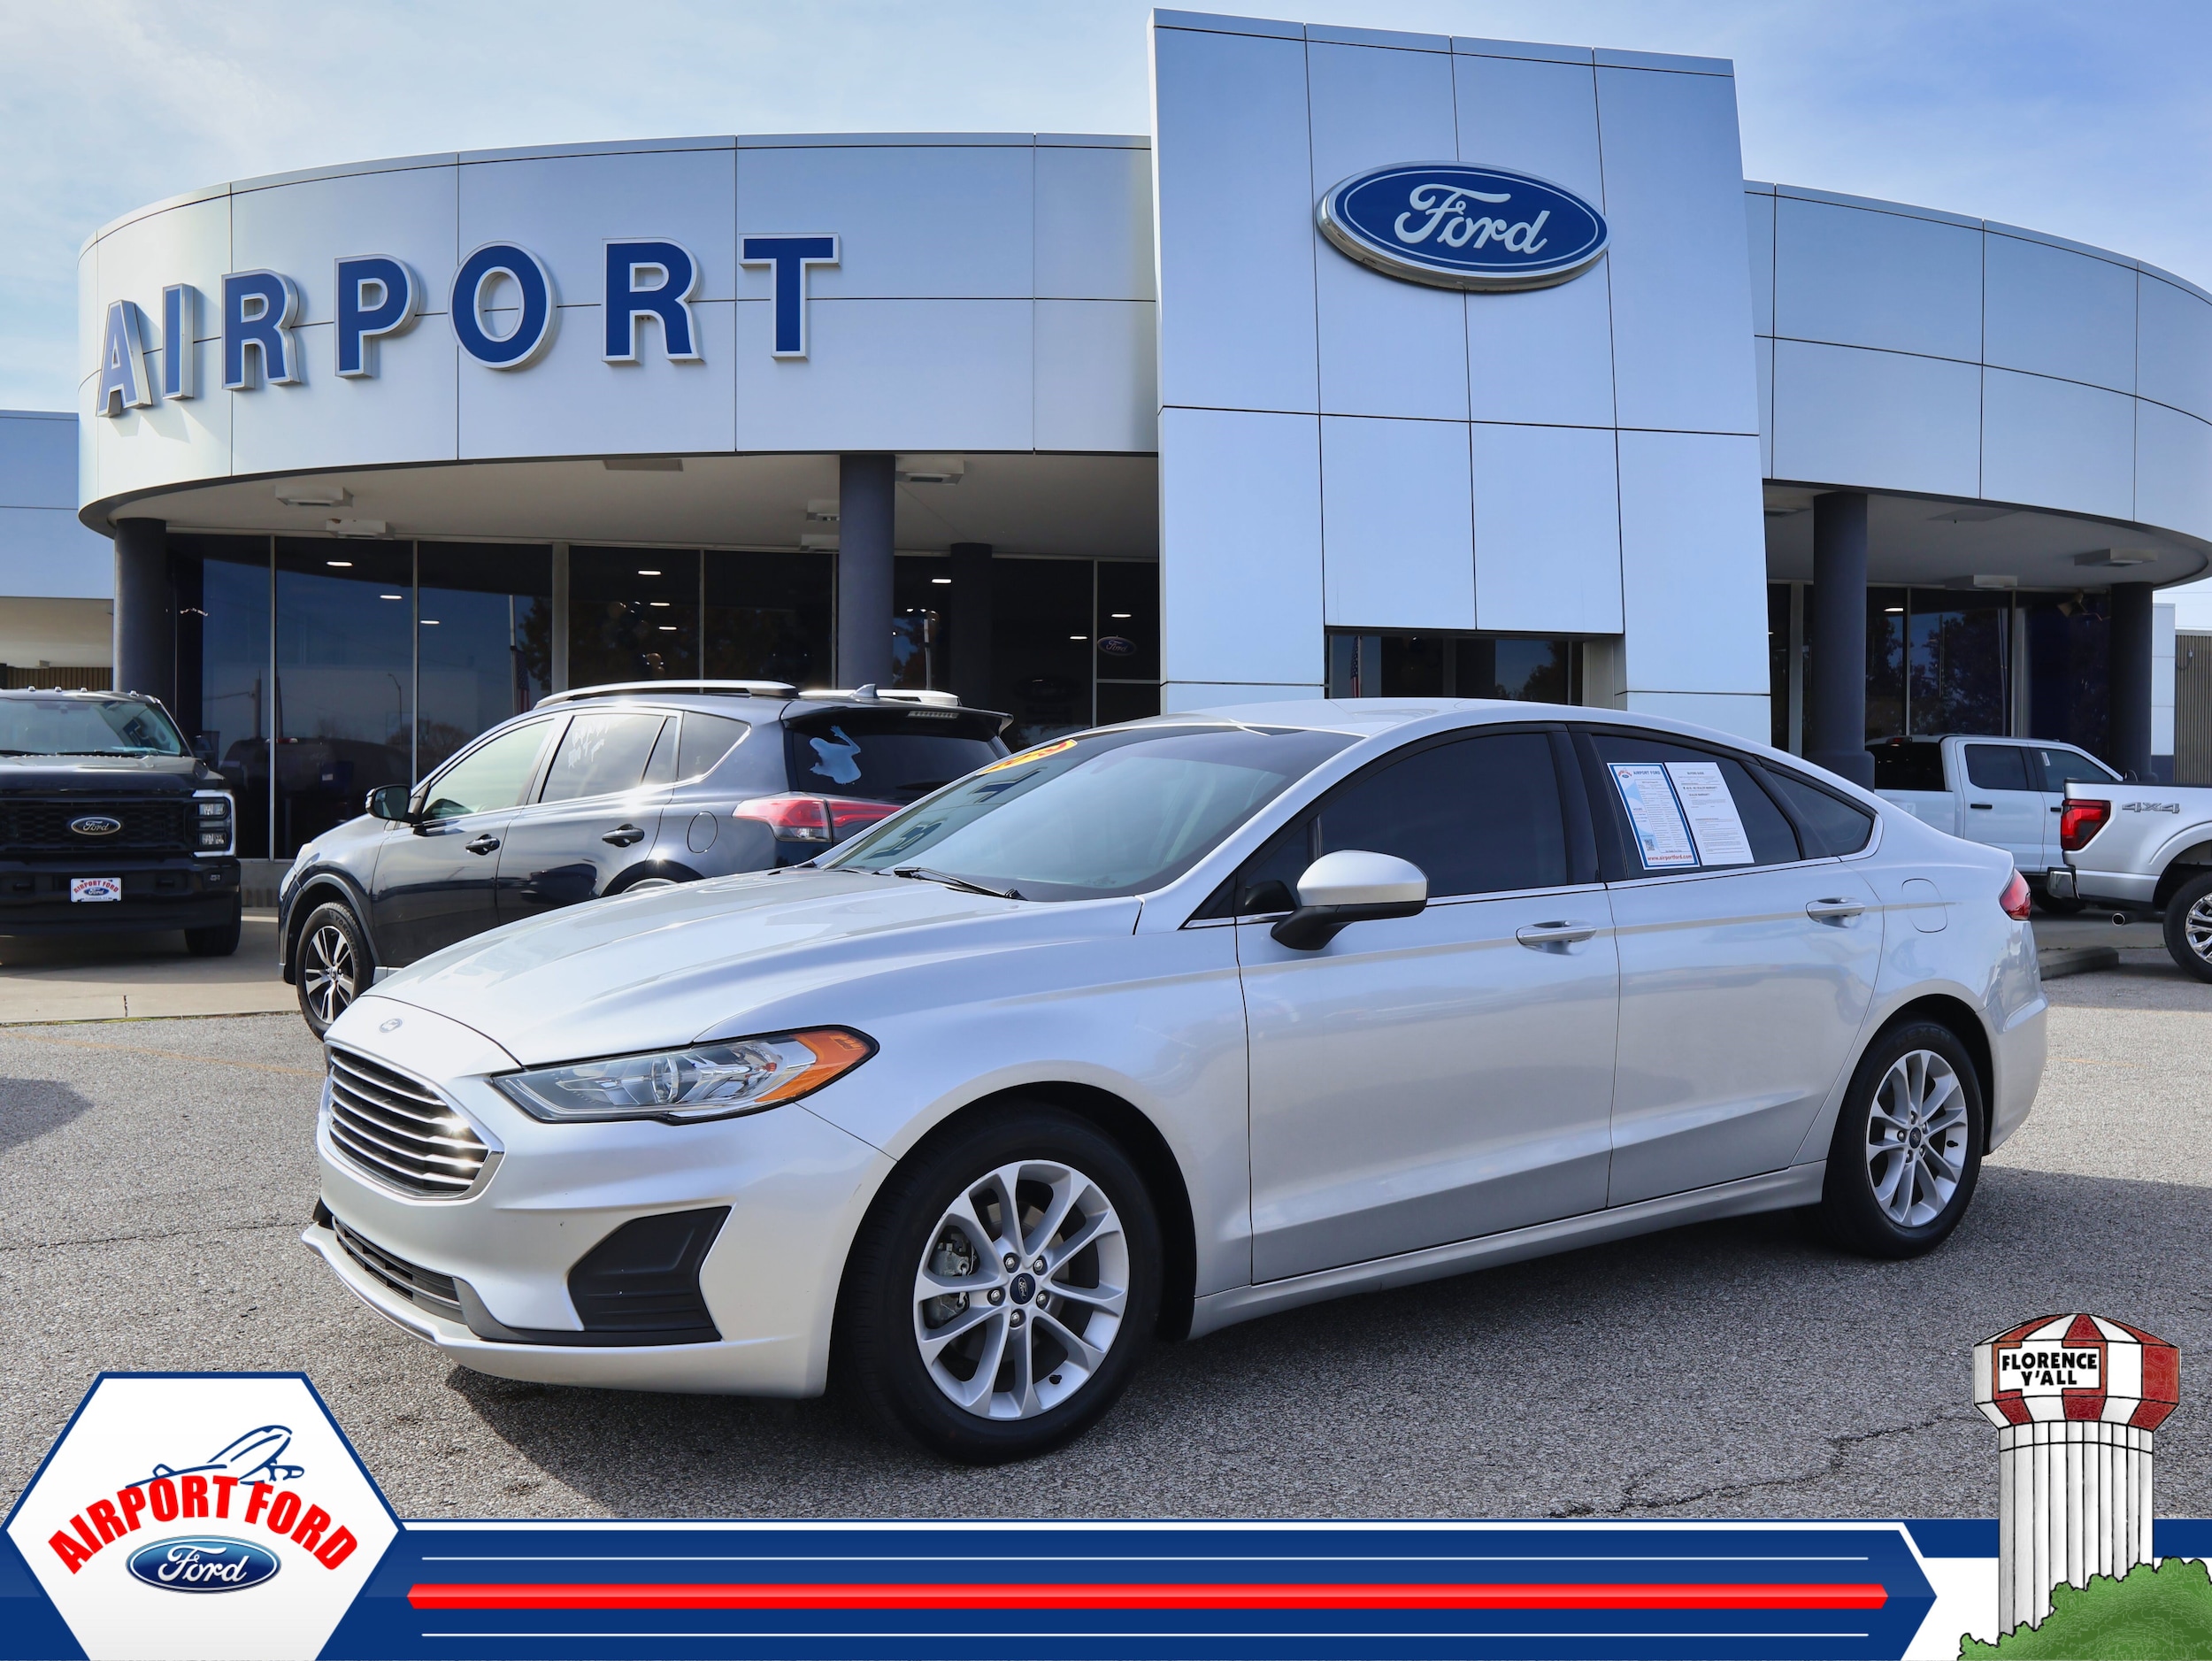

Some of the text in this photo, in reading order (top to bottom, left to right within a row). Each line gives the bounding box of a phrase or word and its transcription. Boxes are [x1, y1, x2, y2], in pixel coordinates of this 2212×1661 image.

[1394, 183, 1550, 255] Ford
[96, 232, 841, 419] AIRPORT
[1106, 640, 1127, 651] Ford
[82, 819, 109, 831] Ford
[73, 880, 119, 894] AIRPORT FORD
